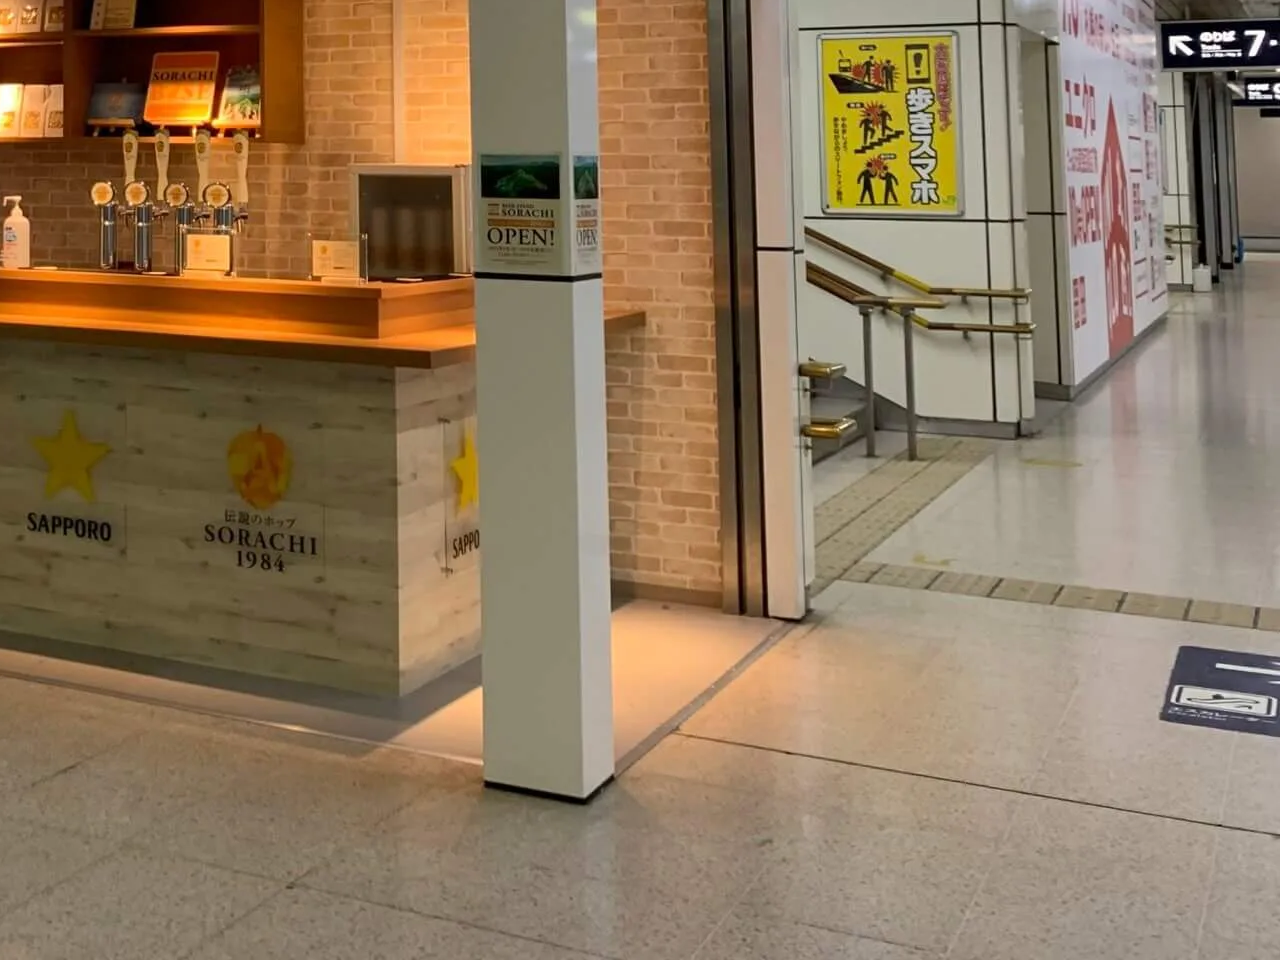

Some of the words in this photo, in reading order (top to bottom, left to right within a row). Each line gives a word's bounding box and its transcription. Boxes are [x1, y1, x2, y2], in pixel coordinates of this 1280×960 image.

[153, 70, 215, 82] SORACHI
[905, 86, 937, 205] 歩きスマホ
[501, 208, 555, 219] SORACHI
[487, 227, 555, 246] OPEN!
[26, 512, 112, 542] SAPPORO
[224, 508, 298, 529] 伝説のホップ
[204, 523, 318, 556] SORACHI
[452, 529, 480, 559] SAPPO
[235, 550, 286, 573] 1984
